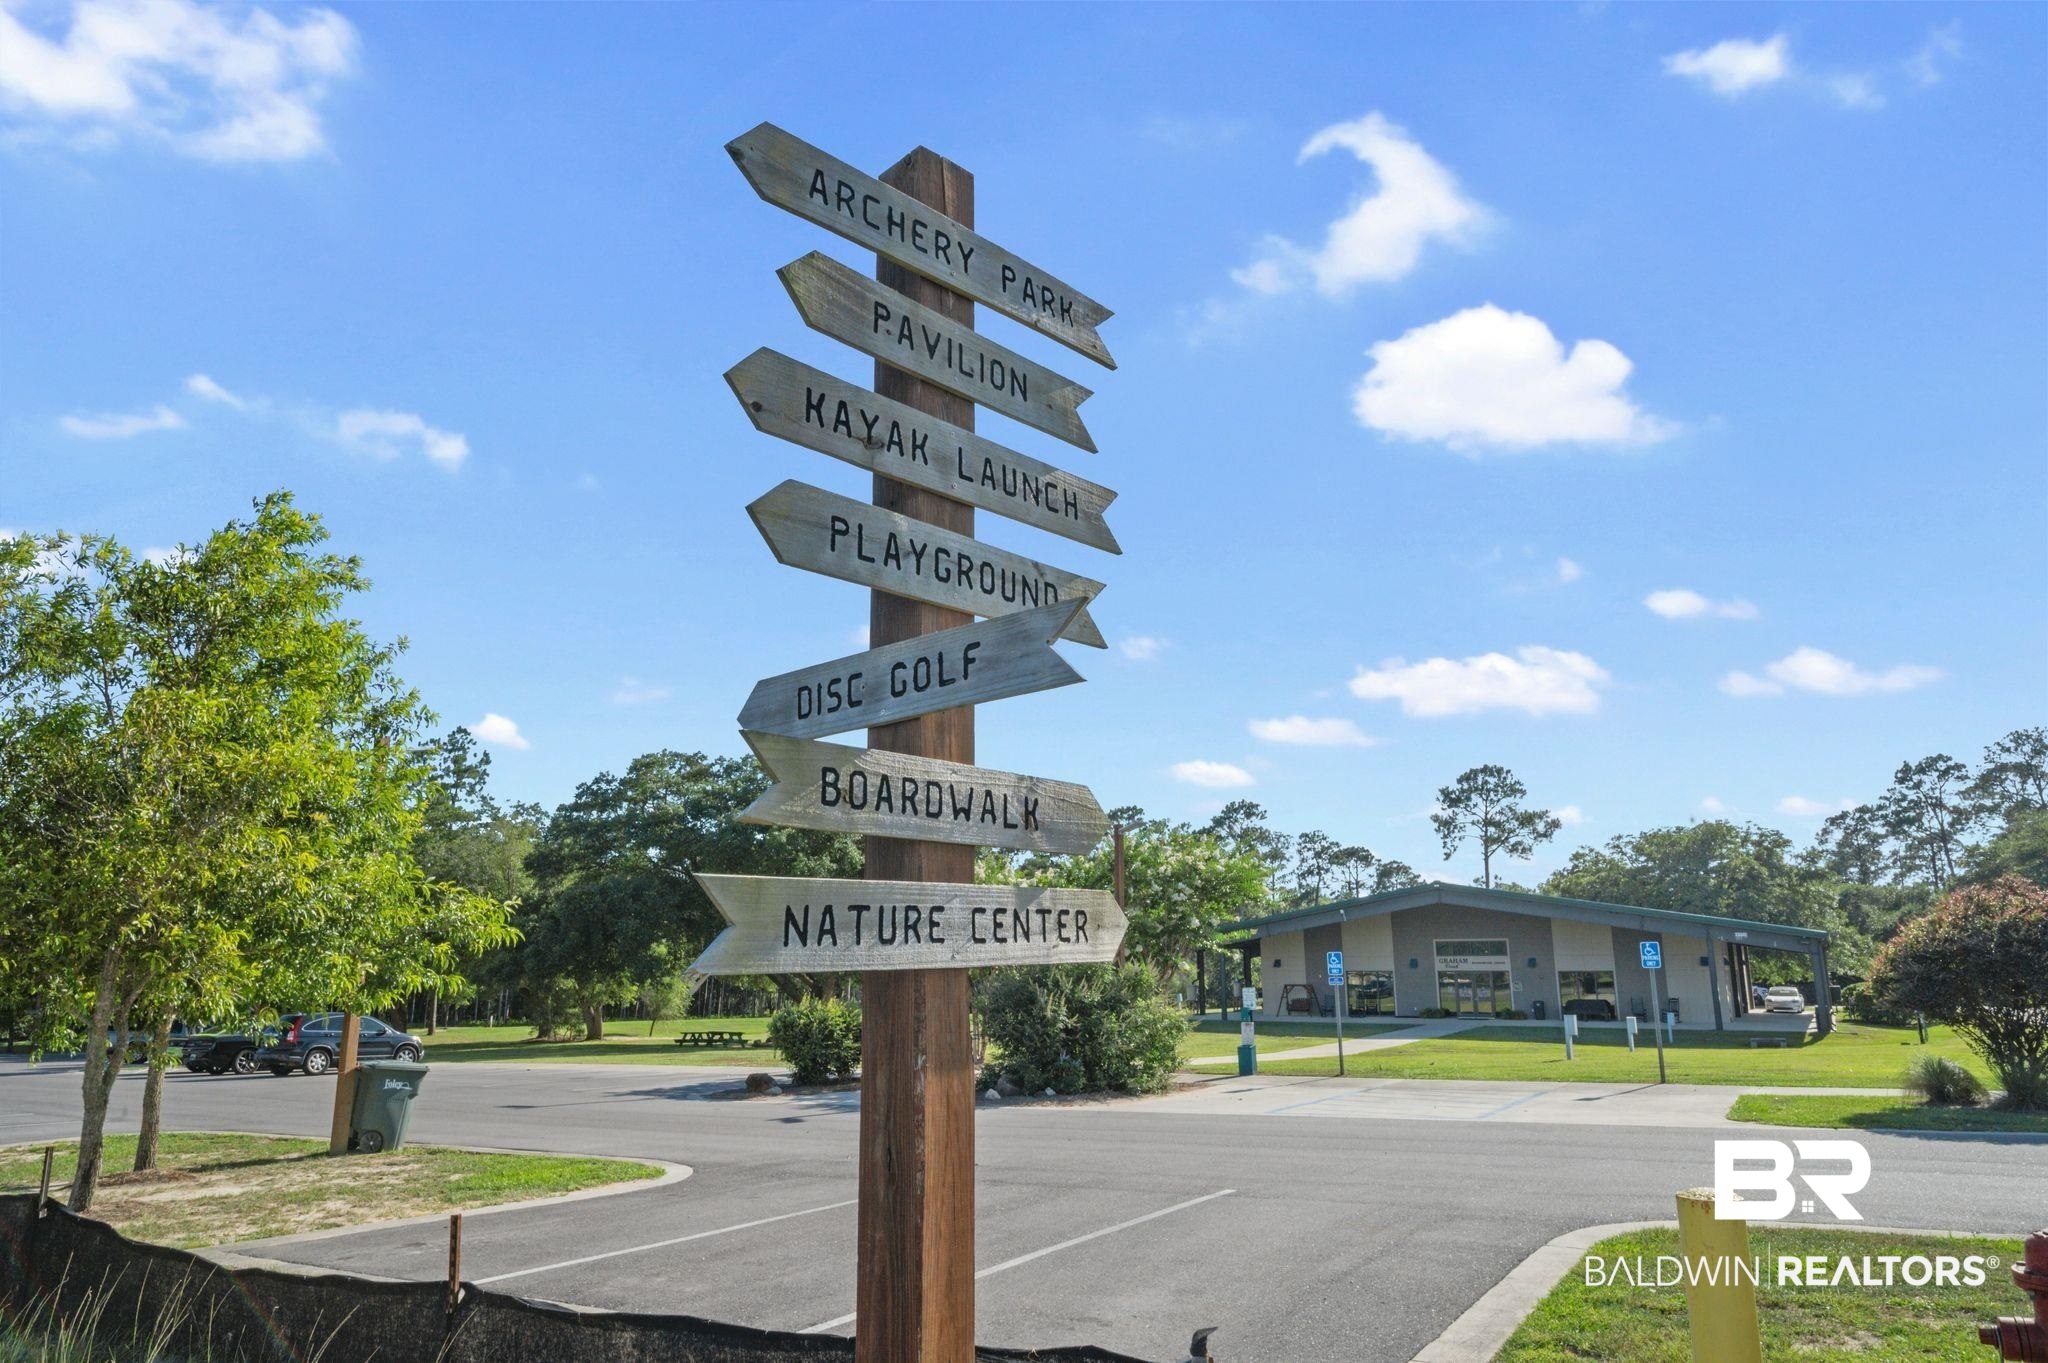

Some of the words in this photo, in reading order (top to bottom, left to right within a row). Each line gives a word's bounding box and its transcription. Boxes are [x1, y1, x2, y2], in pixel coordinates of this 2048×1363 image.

[808, 167, 975, 274] ARCHERY
[1001, 263, 1074, 328] PARK
[873, 301, 1028, 403] PAVILION
[804, 386, 929, 466] KAYAK
[957, 446, 1079, 521] LAUNCH
[829, 514, 1059, 608] PLAYGROUND
[797, 672, 864, 721] DISC
[890, 641, 981, 699] GOLF
[820, 766, 1040, 832] BOARDWALK
[782, 903, 946, 948] NATURE
[971, 906, 1089, 945] CENTER
